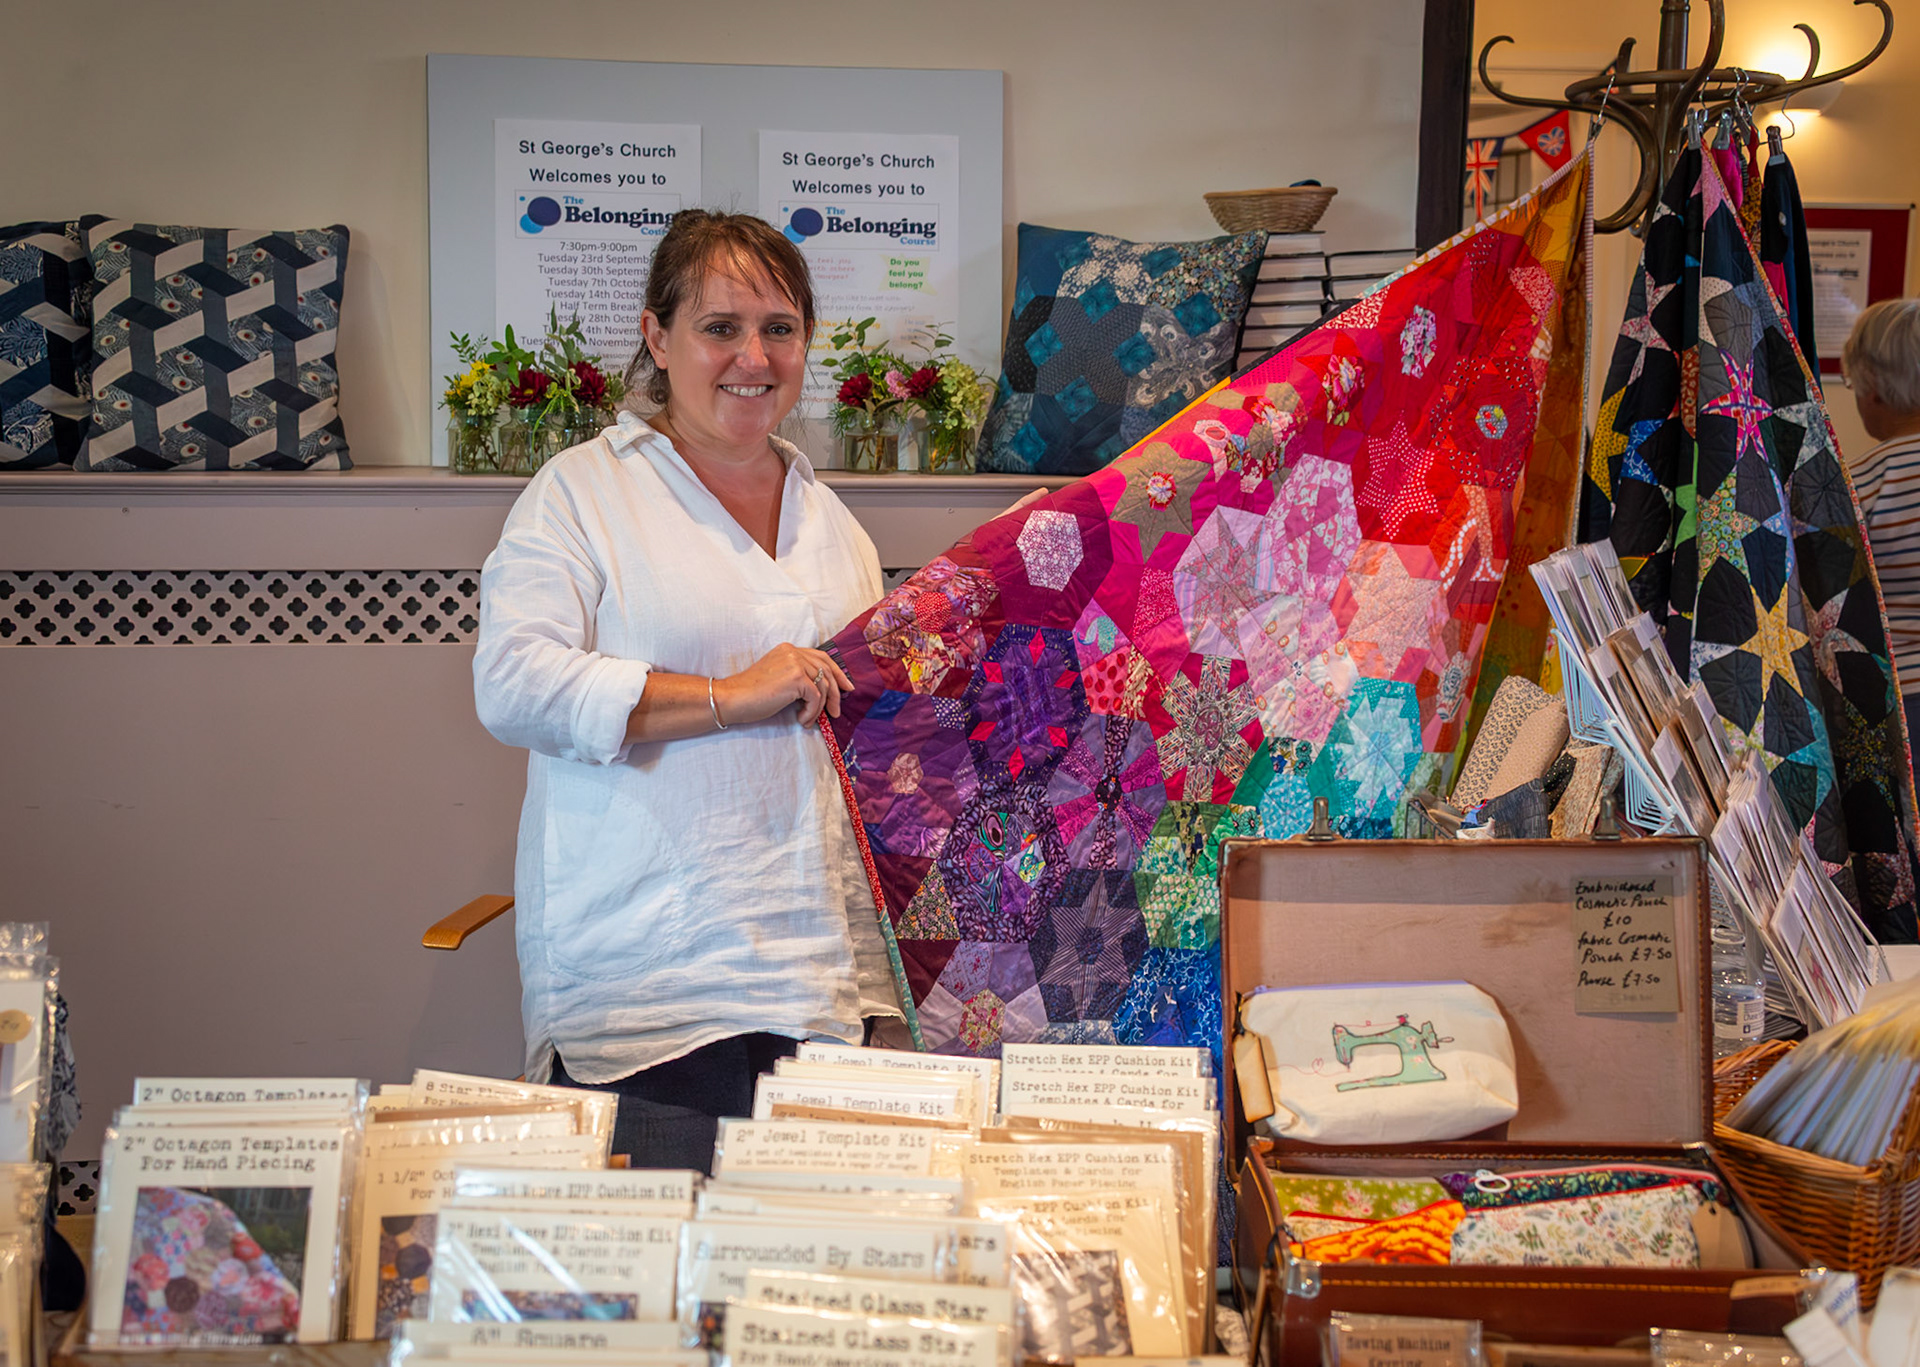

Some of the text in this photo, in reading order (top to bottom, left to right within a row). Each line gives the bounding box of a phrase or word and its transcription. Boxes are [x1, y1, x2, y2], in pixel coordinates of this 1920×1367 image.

[519, 140, 676, 159] St George's Church
[782, 152, 935, 170] St George's Church
[529, 168, 667, 187] Welcomes you to
[792, 179, 925, 197] Welcomes you to
[562, 196, 584, 205] The
[564, 206, 674, 229] Belonging
[825, 206, 845, 215] The
[640, 227, 664, 236] Cou
[826, 216, 936, 238] Belonging
[560, 241, 637, 253] 7:30pm-9:00pm
[900, 237, 936, 246] Course
[538, 253, 650, 267] Tuesday 23rd Septemb
[890, 258, 920, 267] Do you
[538, 265, 649, 277] Tuesday 30th Septemb
[549, 277, 646, 288] Tuesday 7th Octobe
[889, 281, 923, 290] belong?
[546, 289, 642, 300] Tuesday 14th Octob
[560, 301, 638, 311] Half Term Break
[546, 313, 641, 323] Tesday 28th Octob
[586, 326, 604, 334] 4th
[604, 326, 640, 335] Novem
[589, 338, 641, 347] November
[1602, 912, 1632, 930] £10
[1006, 1054, 1193, 1067] Stretch Hex EPP Cushion Kit
[171, 1088, 246, 1103] Octagon
[426, 1081, 473, 1096] 8 Star
[1012, 1081, 1200, 1097] Stretch Hex EPP Cushion Kit
[423, 1096, 444, 1106] For
[795, 1093, 833, 1108] Jewel
[843, 1097, 912, 1115] Template
[918, 1101, 945, 1116] Kit
[1116, 1098, 1156, 1108] Cards
[1161, 1099, 1185, 1110] for
[122, 1136, 340, 1154] 2" Octagon Templates
[736, 1129, 927, 1148] 2" Jewel Template Kit
[141, 1155, 317, 1173] For Hand Piecing
[969, 1154, 1024, 1164] Stretch
[1028, 1154, 1052, 1164] Hex
[1057, 1154, 1081, 1163] EPP
[1085, 1153, 1139, 1164] Cushion
[411, 1188, 436, 1200] For
[598, 1185, 655, 1200] Cushion
[660, 1185, 685, 1201] Kit
[1033, 1202, 1060, 1213] EPP
[1125, 1199, 1150, 1209] Kit
[960, 1234, 997, 1250] ars
[694, 1241, 925, 1269] Surrounded By Stars
[762, 1287, 988, 1321] Stained Glass Star
[741, 1323, 976, 1357] Stained Glass Star
